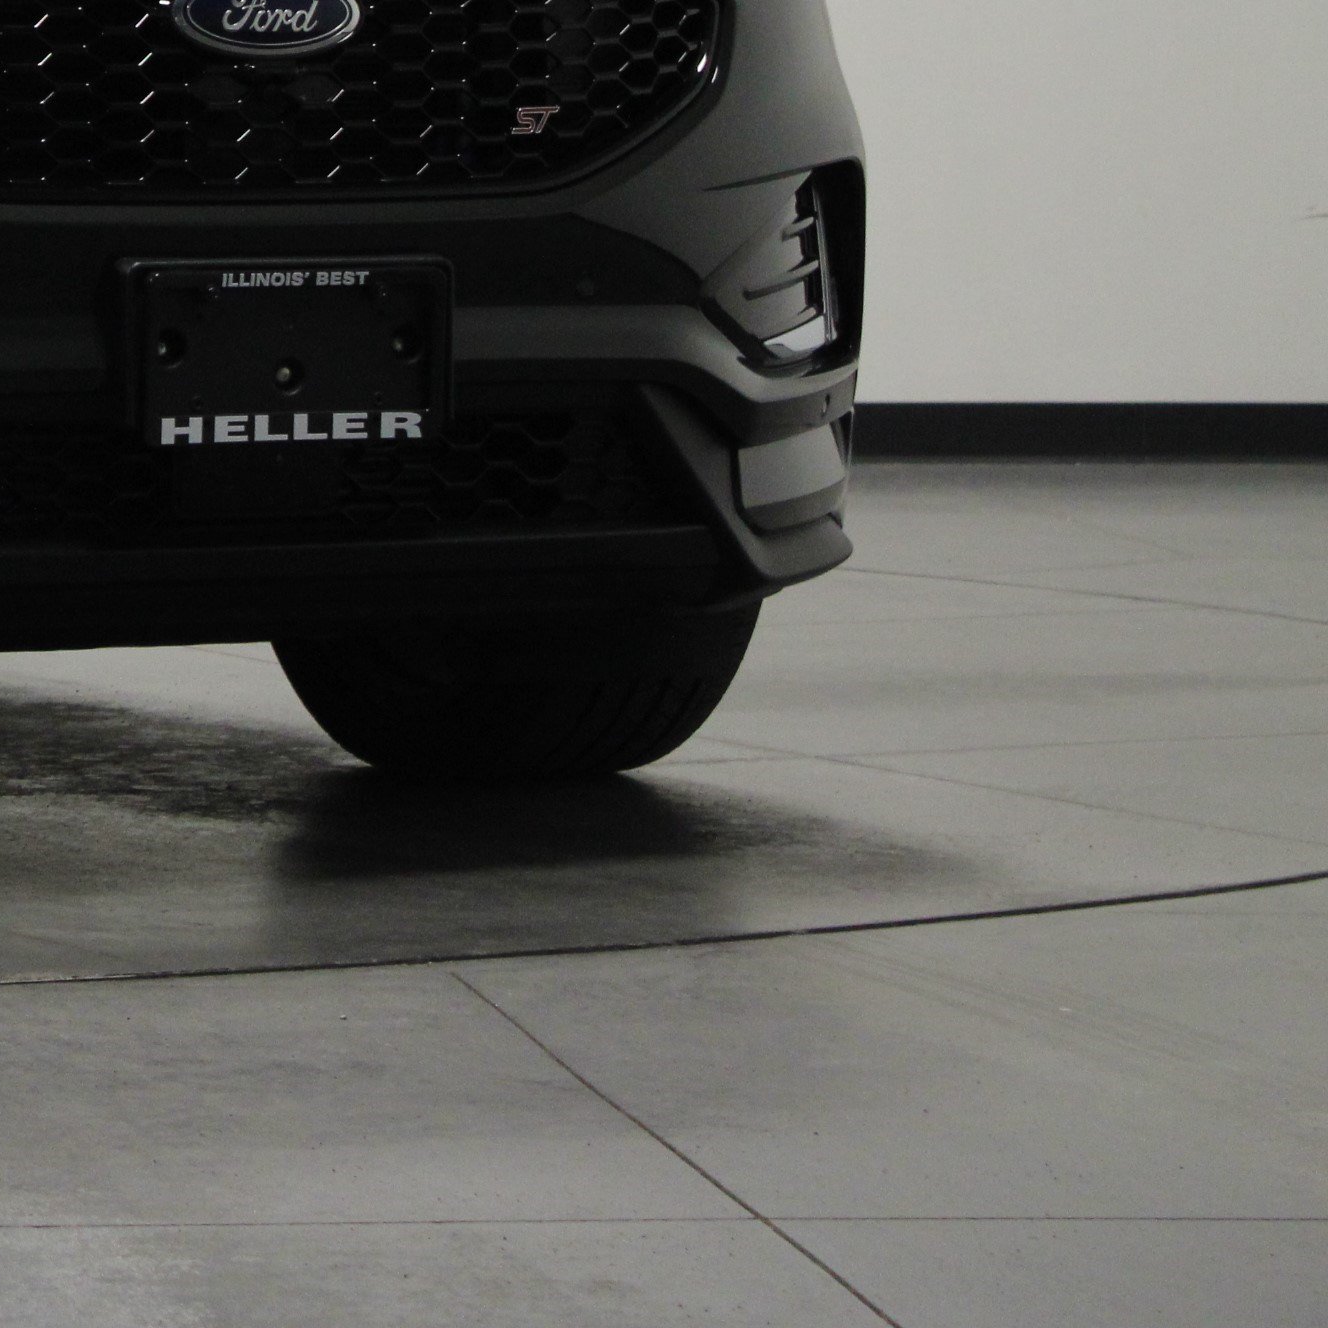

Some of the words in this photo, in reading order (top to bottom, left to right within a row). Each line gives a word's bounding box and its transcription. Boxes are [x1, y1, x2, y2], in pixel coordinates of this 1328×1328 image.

[511, 105, 561, 135] ST
[315, 270, 370, 287] BEST
[160, 411, 423, 446] HELLER
